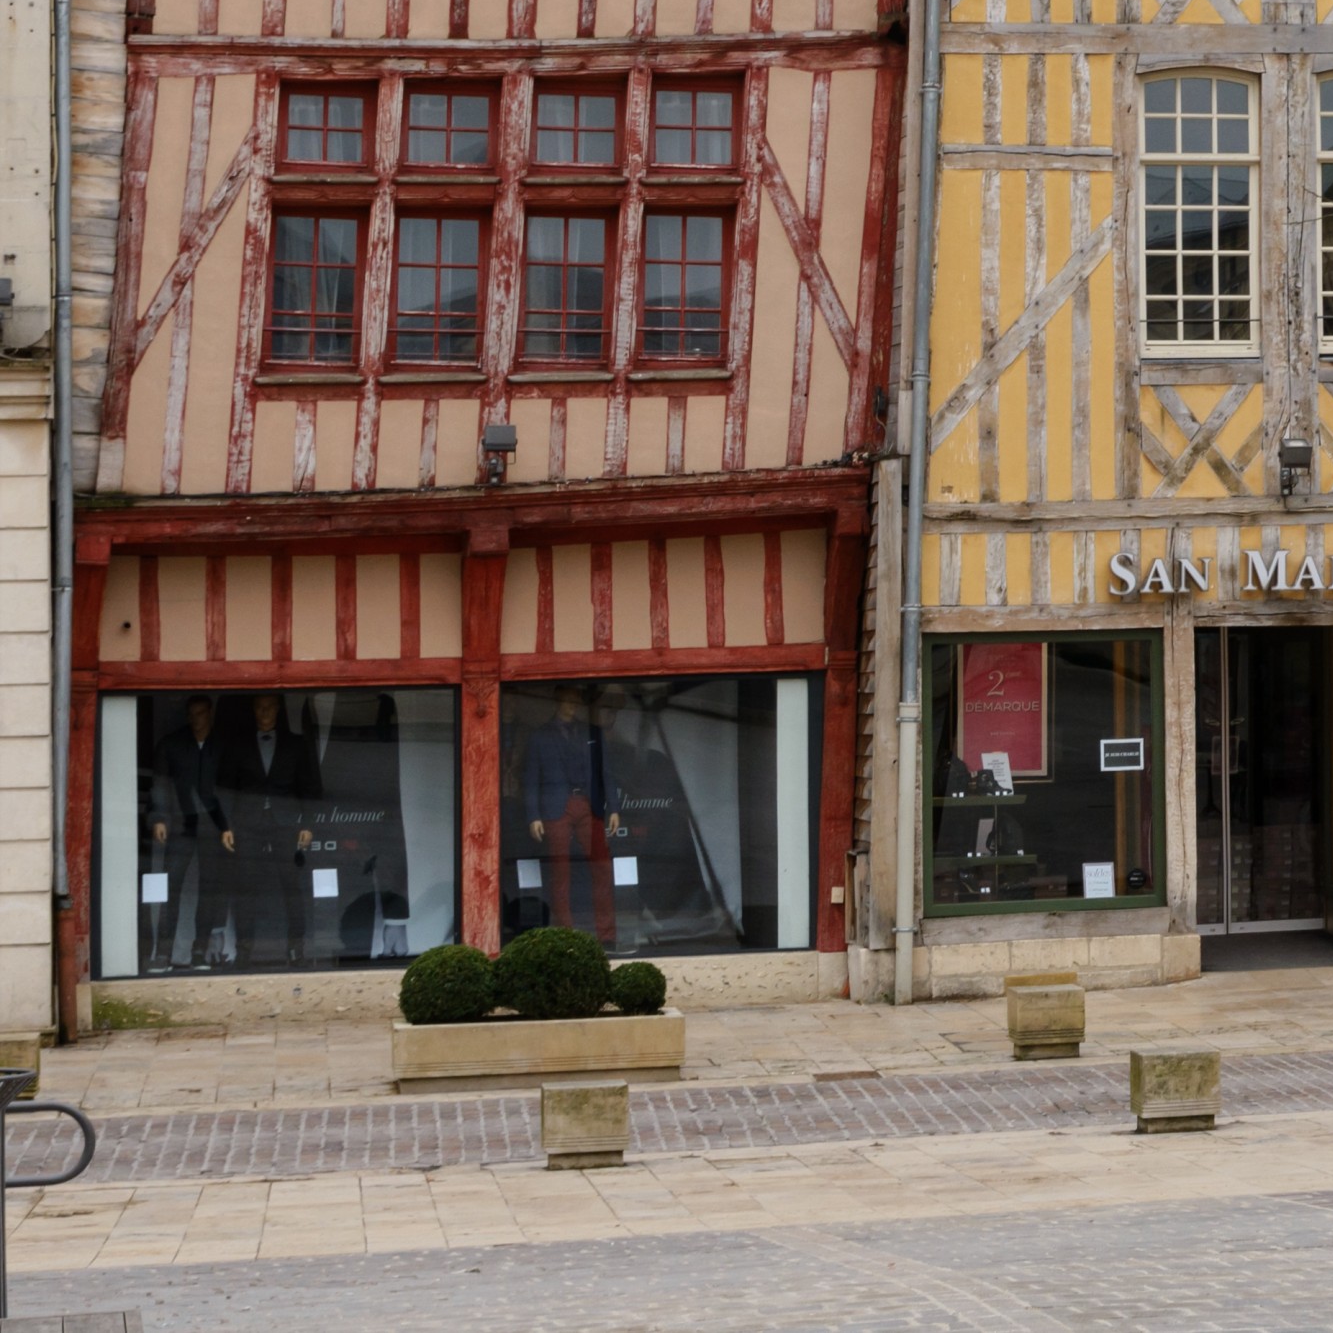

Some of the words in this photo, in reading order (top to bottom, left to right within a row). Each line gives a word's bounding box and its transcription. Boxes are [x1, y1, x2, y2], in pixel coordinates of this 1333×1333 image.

[1109, 551, 1213, 596] SAN
[965, 698, 1040, 713] DÉMARQUE
[621, 793, 673, 809] homme
[330, 805, 385, 823] homme
